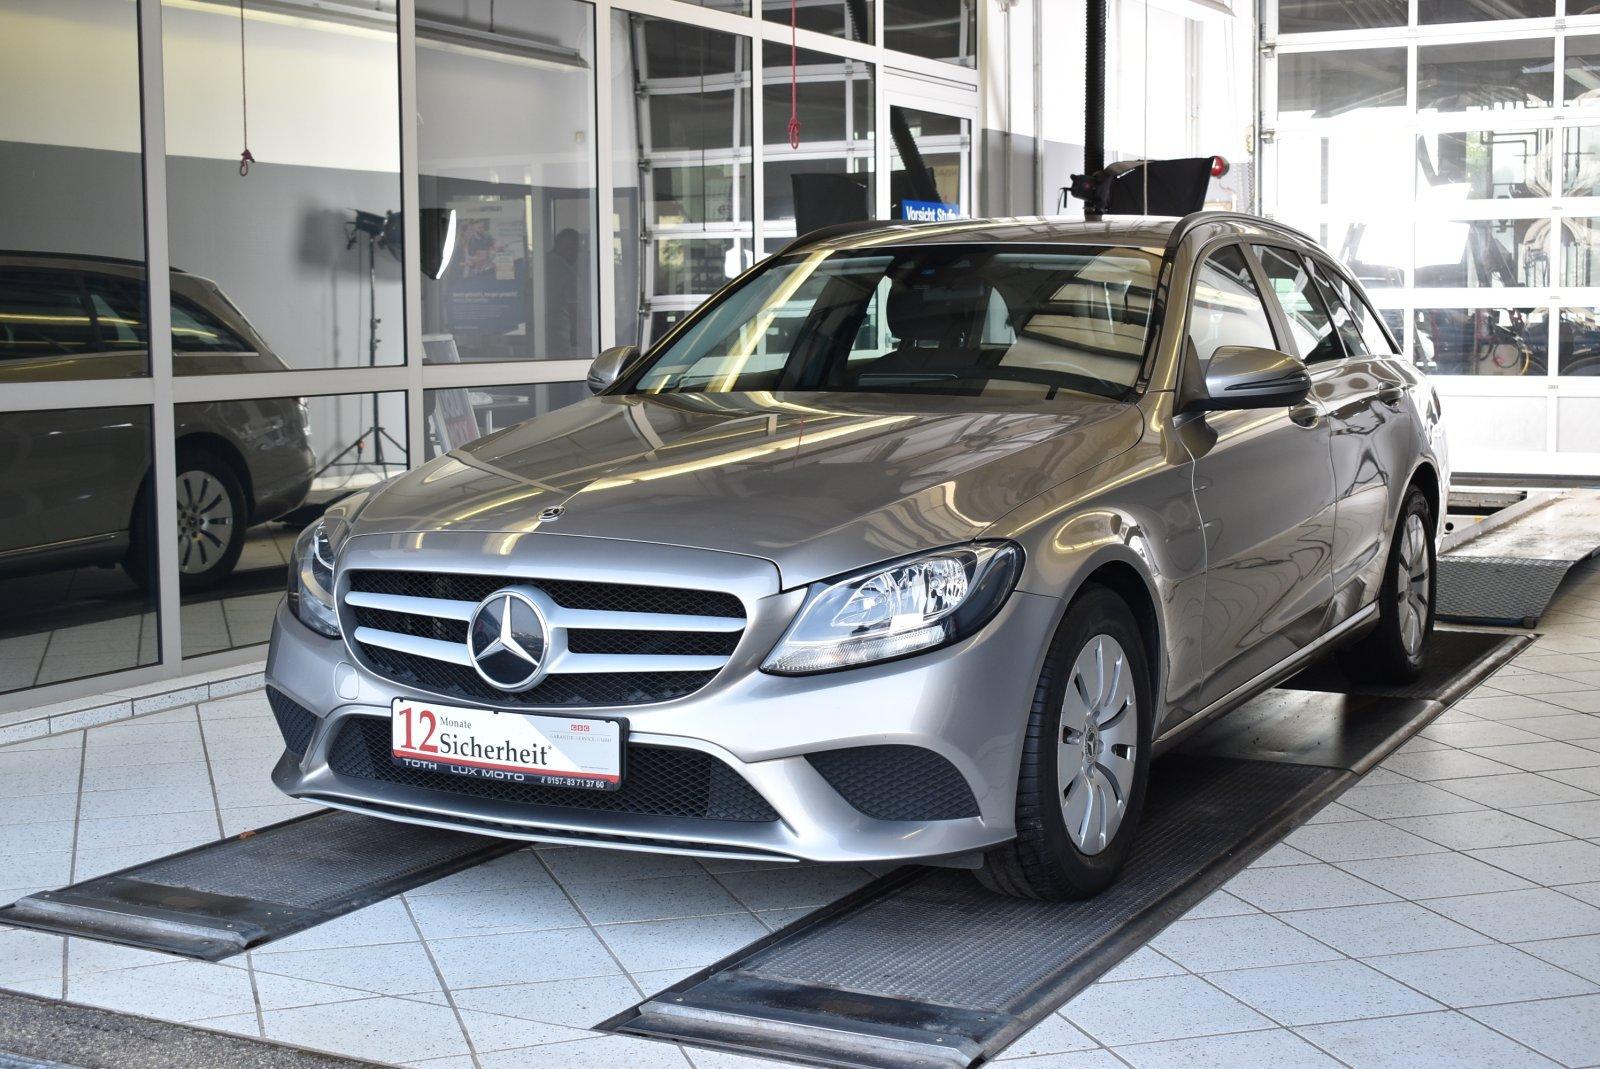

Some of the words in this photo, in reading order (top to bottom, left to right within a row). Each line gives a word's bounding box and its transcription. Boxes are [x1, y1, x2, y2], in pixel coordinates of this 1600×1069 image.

[906, 206, 935, 221] Vorsicht
[399, 707, 438, 753] 12
[440, 716, 472, 729] Monate
[403, 758, 438, 770] TOTH
[450, 765, 478, 776] LUX
[481, 769, 525, 781] MOTO
